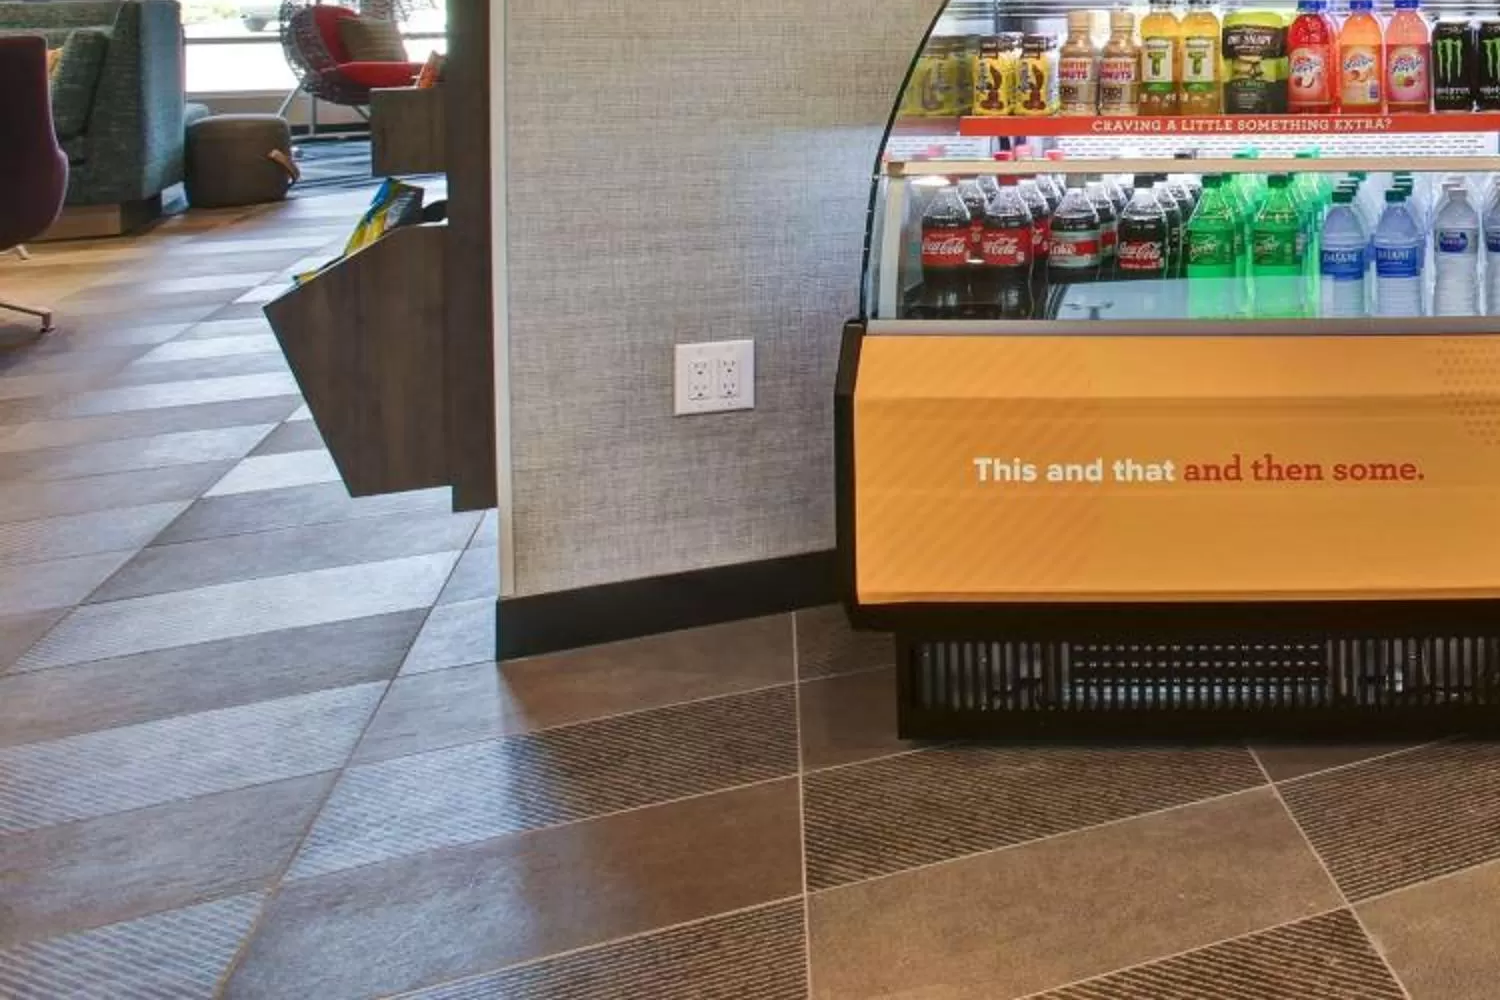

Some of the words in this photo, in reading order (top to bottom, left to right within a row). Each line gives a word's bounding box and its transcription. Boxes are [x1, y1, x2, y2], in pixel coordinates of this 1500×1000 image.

[1092, 119, 1161, 132] CRAVING
[1165, 119, 1178, 131] A
[1181, 119, 1233, 132] LITTLE
[1237, 118, 1329, 131] SOMETHING
[1334, 118, 1393, 131] EXTRA?
[972, 456, 1038, 481] This
[1046, 456, 1104, 482] and
[1112, 457, 1176, 482] that
[1183, 453, 1243, 482] and
[1250, 453, 1324, 481] then
[1333, 461, 1425, 481] some.
